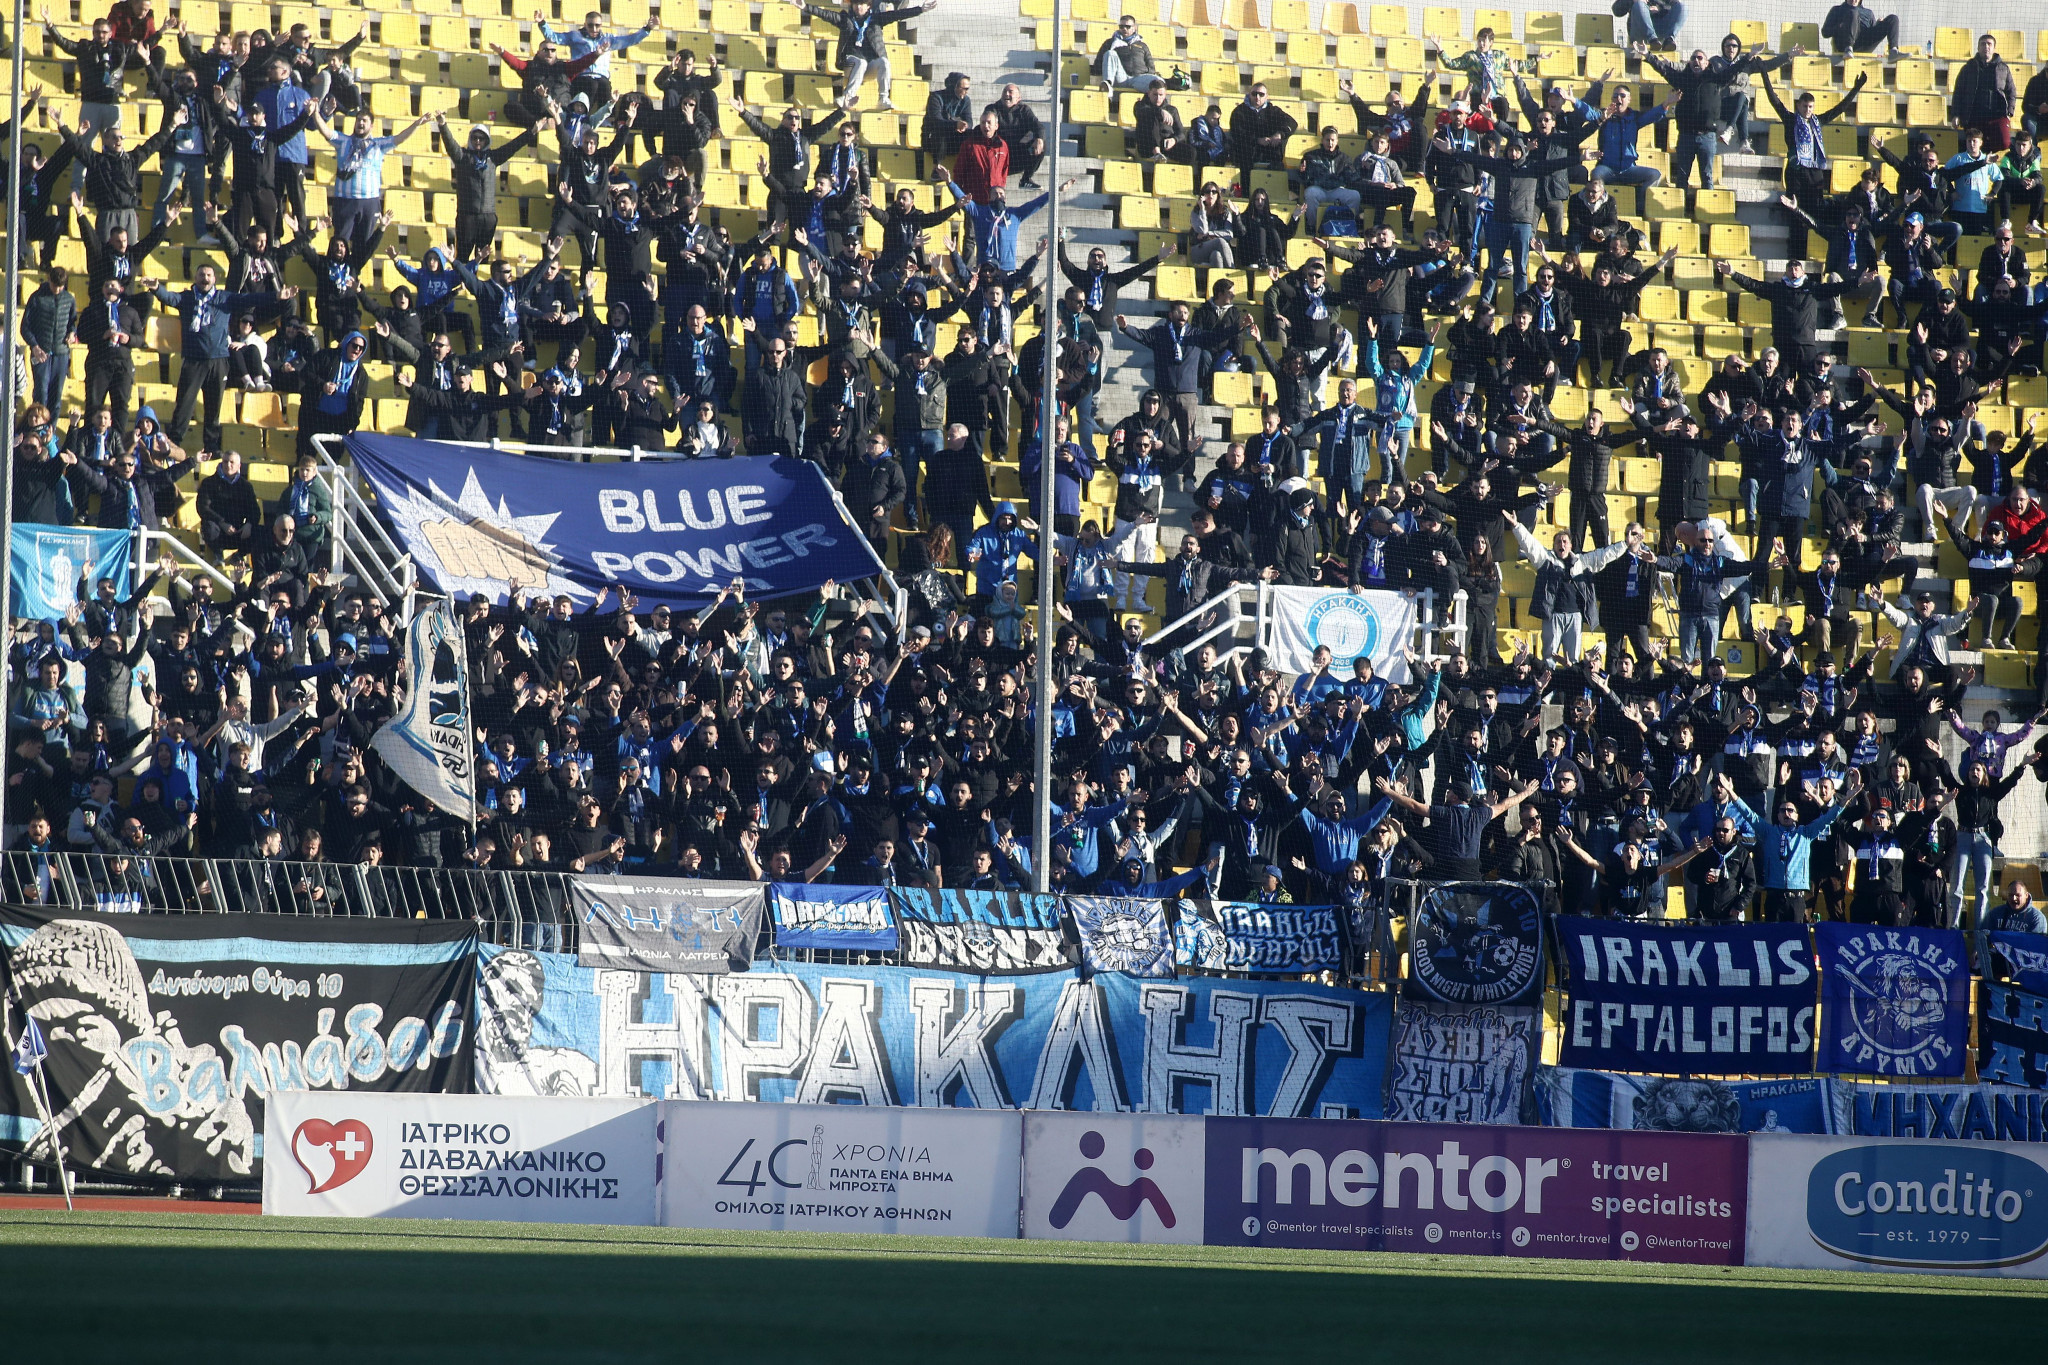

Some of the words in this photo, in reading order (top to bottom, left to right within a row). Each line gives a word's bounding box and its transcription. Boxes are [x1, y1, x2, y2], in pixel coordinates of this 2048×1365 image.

[598, 485, 774, 533] BLUE
[591, 523, 838, 583] POWER
[1314, 597, 1373, 619] ΗΡΑΚΛΗΣ
[635, 887, 702, 896] ΗΡΑΚΛΗΣ
[1222, 906, 1338, 938] IRAKLIS
[630, 948, 671, 960] ΑΙΩΝΙΑ
[678, 952, 730, 961] ΛΑΤΡΕΙΑ
[1225, 937, 1341, 966] NEAPOLI
[1578, 934, 1810, 986] IRAKLIS
[1838, 931, 1958, 975] ΗΡΑΚΛΗΣ
[1416, 938, 1435, 977] GOOD
[1430, 972, 1470, 1000] NIGHT
[1473, 977, 1515, 1001] WHITE
[1507, 944, 1536, 984] PRIDE
[149, 968, 249, 999] Αυτόνομη
[252, 966, 311, 1001] Θύρα
[317, 973, 344, 997] 10
[1572, 1000, 1814, 1053] EPTALOFOS
[594, 968, 1355, 1118] ΗΡΑΚΛΗΣ
[1840, 1031, 1952, 1075] ΔΡΥΜΟΣ
[1751, 1080, 1816, 1099] ΗΡΑΚΛΗΣ
[401, 1123, 510, 1144] ΙΑΤΡΙΚΟ
[400, 1150, 606, 1173] ΔΙΑΒΑΛΚΑΝΙΚΟ
[832, 1144, 931, 1163] ΧΡΟΝΙΑ
[830, 1168, 878, 1179] ΠΑΝΤΑ
[881, 1169, 909, 1181] ΕΝΑ
[913, 1171, 954, 1182] ΒΗΜΑ
[1592, 1160, 1668, 1182] travel
[400, 1175, 619, 1199] ΘΕΣΣΑΛΟΝΙΚΗΣ
[829, 1181, 896, 1193] ΜΠΡΟΣΤΑ
[1834, 1169, 2022, 1222] Condito
[715, 1201, 784, 1215] ΟΜΙΛΟΣ
[790, 1204, 869, 1218] ΙΑΤΡΙΚΟΥ
[873, 1207, 951, 1221] ΑΘΗΝΩΝ
[1591, 1193, 1731, 1219] specialists
[1267, 1220, 1317, 1233] @mentor
[1321, 1223, 1352, 1234] travel
[1355, 1224, 1413, 1236] specialists
[1449, 1228, 1501, 1239] mentor.ts
[1536, 1231, 1610, 1244] mentor.travel
[1886, 1230, 1919, 1242] est.
[1927, 1230, 1970, 1244] 1979
[1645, 1235, 1731, 1250] @MentorTravel
